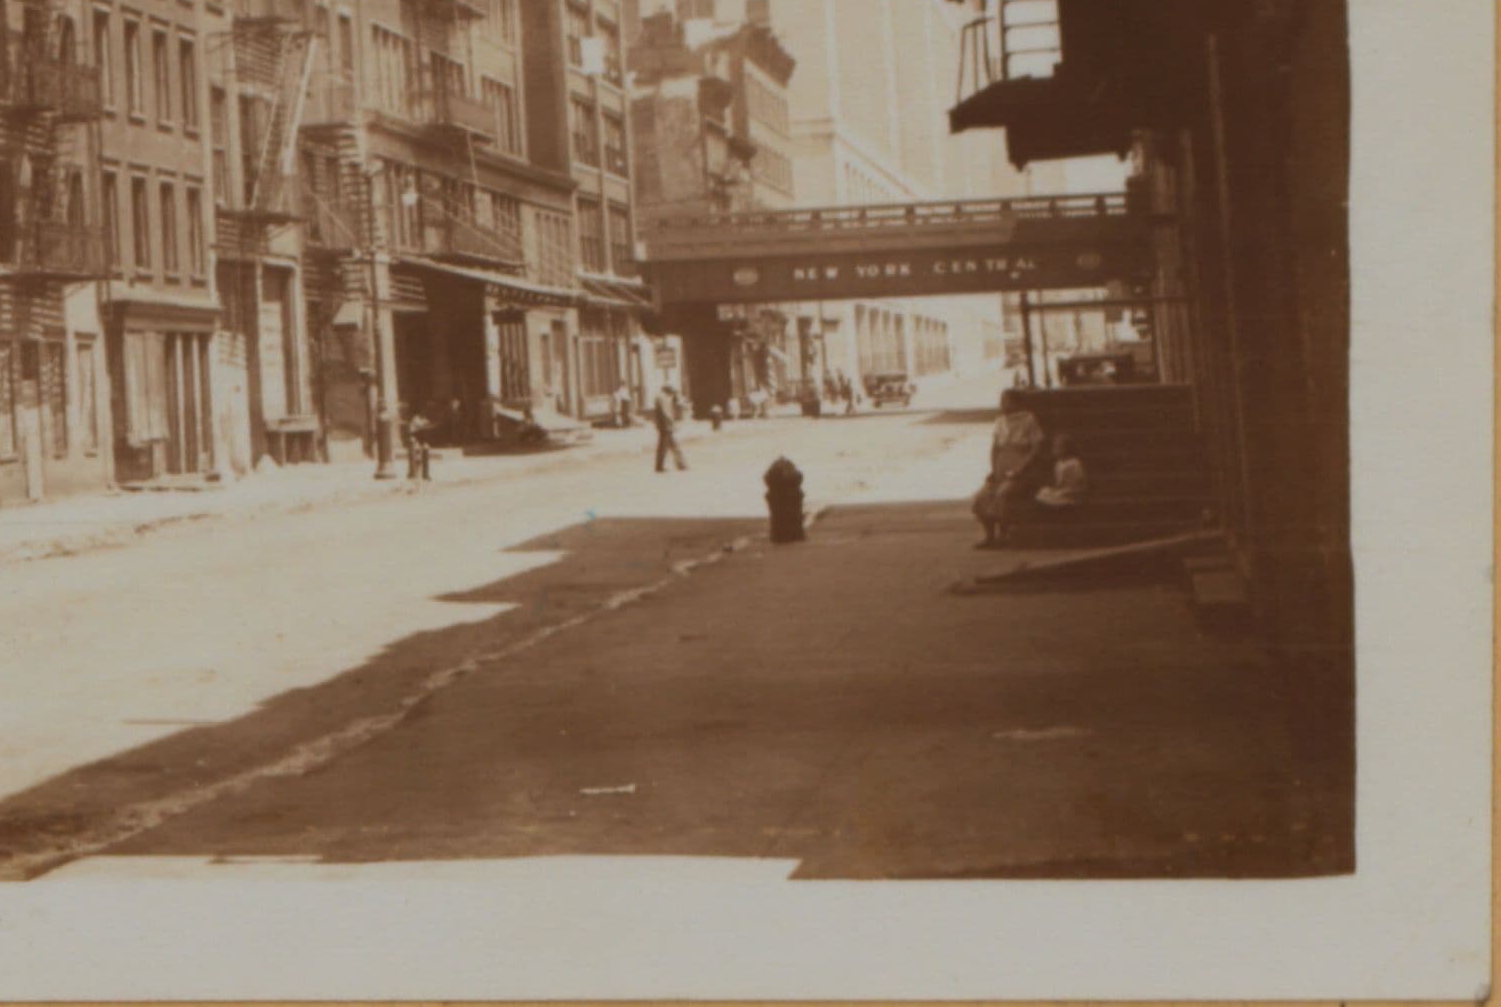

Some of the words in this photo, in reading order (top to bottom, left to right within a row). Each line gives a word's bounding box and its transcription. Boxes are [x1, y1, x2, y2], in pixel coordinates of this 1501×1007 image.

[793, 265, 839, 281] NEW
[855, 262, 911, 279] YORK
[932, 258, 1036, 275] CENTRAL
